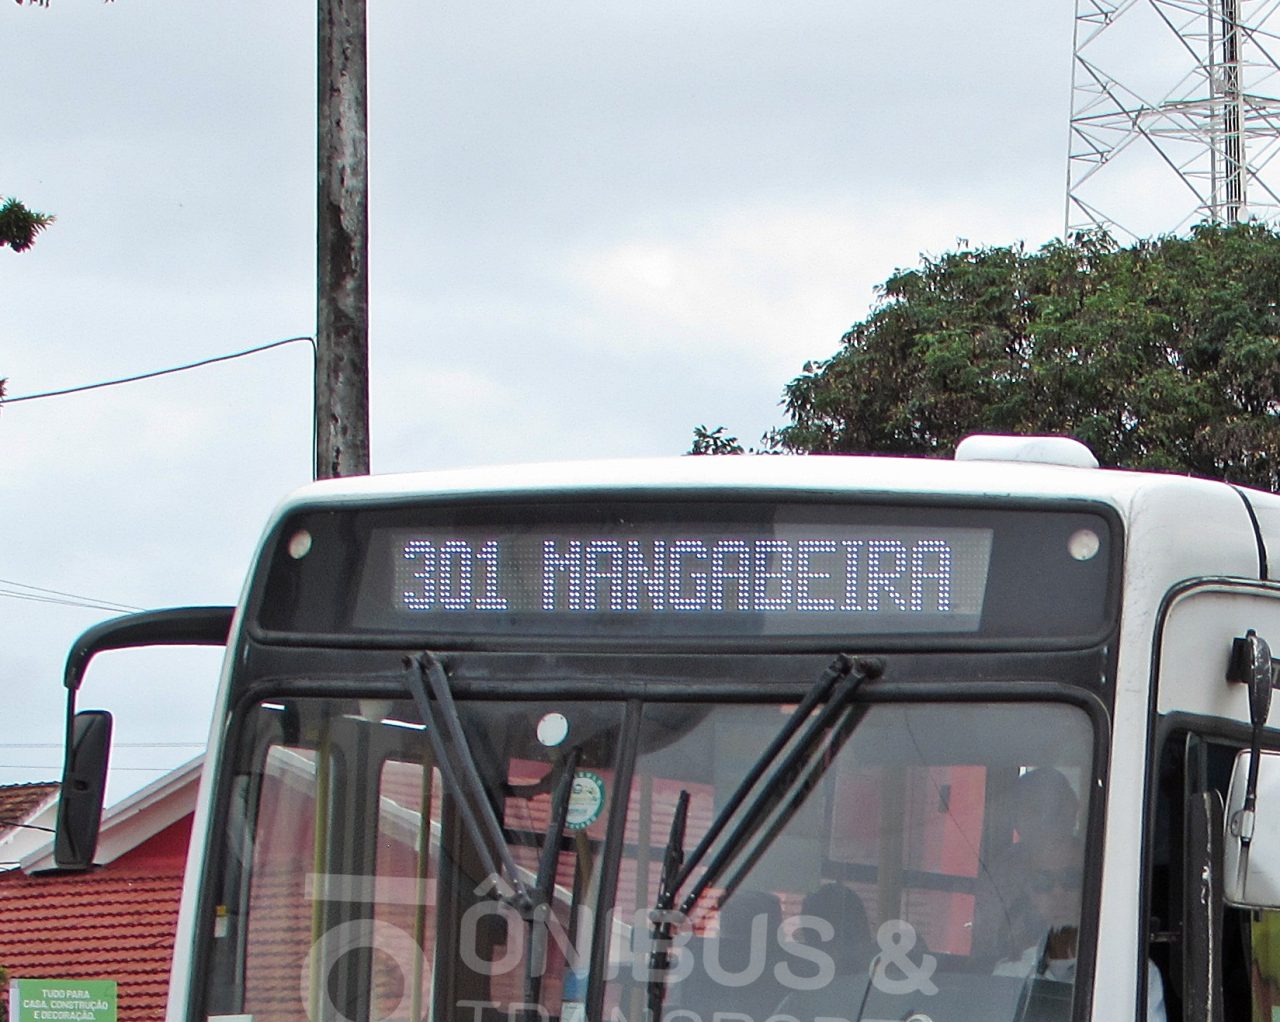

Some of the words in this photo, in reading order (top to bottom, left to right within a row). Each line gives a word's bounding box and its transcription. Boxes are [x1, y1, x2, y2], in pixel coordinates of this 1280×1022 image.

[402, 539, 509, 613] 301
[541, 539, 953, 613] MANGABEIRA
[66, 989, 90, 998] PARA
